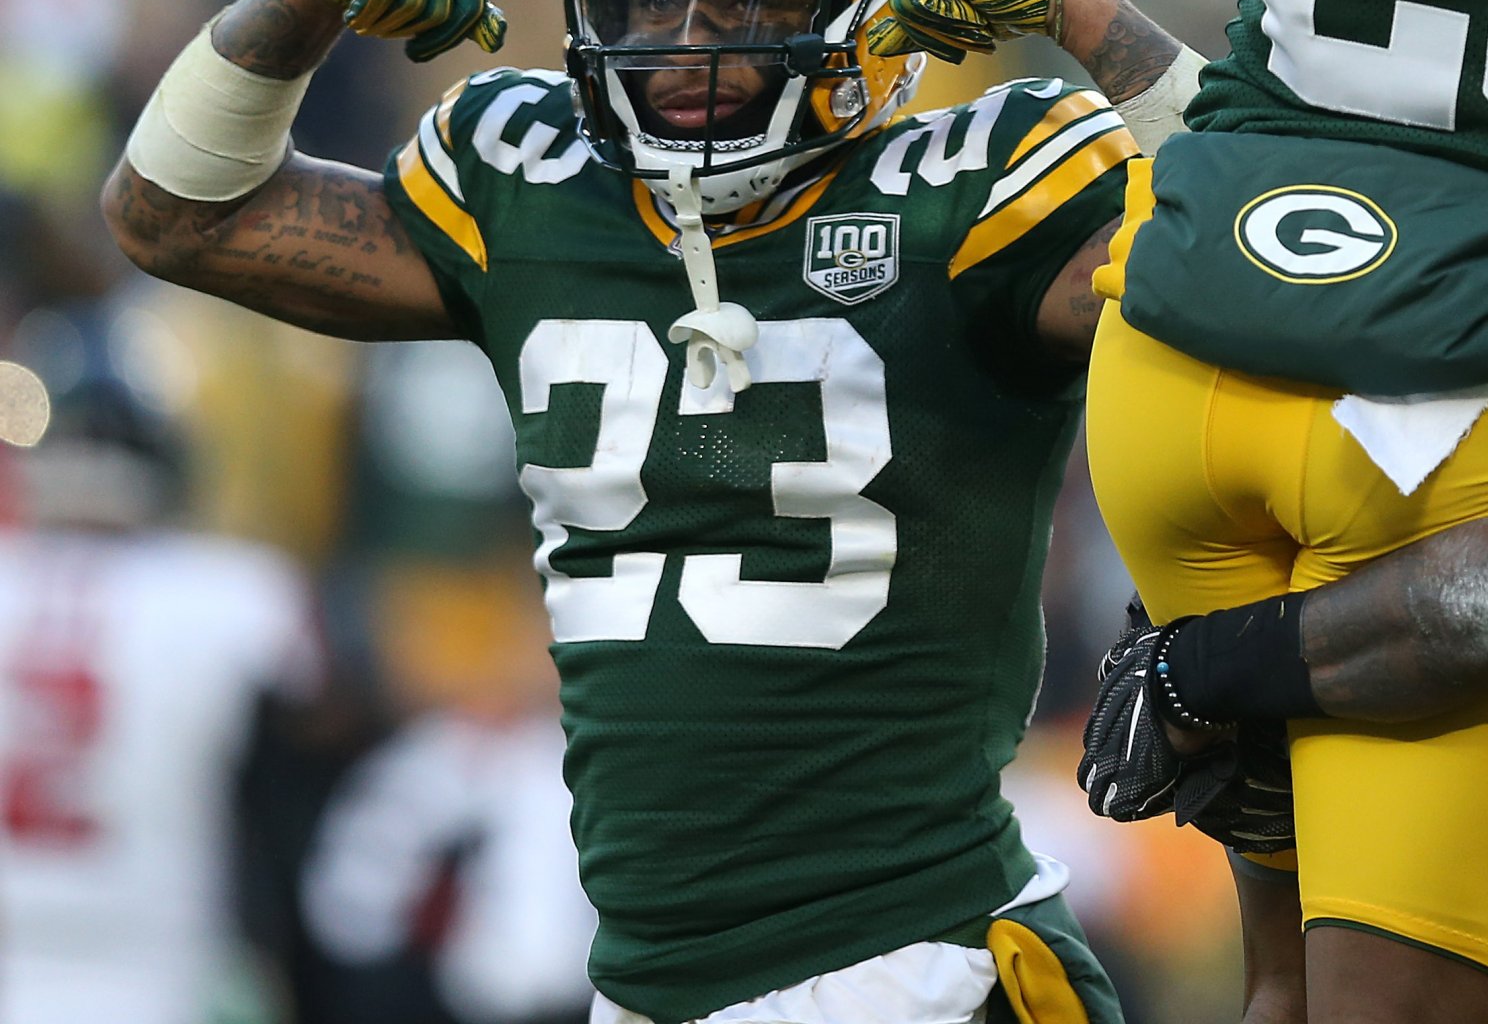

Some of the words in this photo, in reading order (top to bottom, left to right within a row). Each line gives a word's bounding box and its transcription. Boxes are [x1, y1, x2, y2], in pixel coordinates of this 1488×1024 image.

[817, 225, 887, 259] 100
[1245, 194, 1385, 275] G
[824, 263, 886, 289] SEASONS
[519, 318, 897, 650] 23
